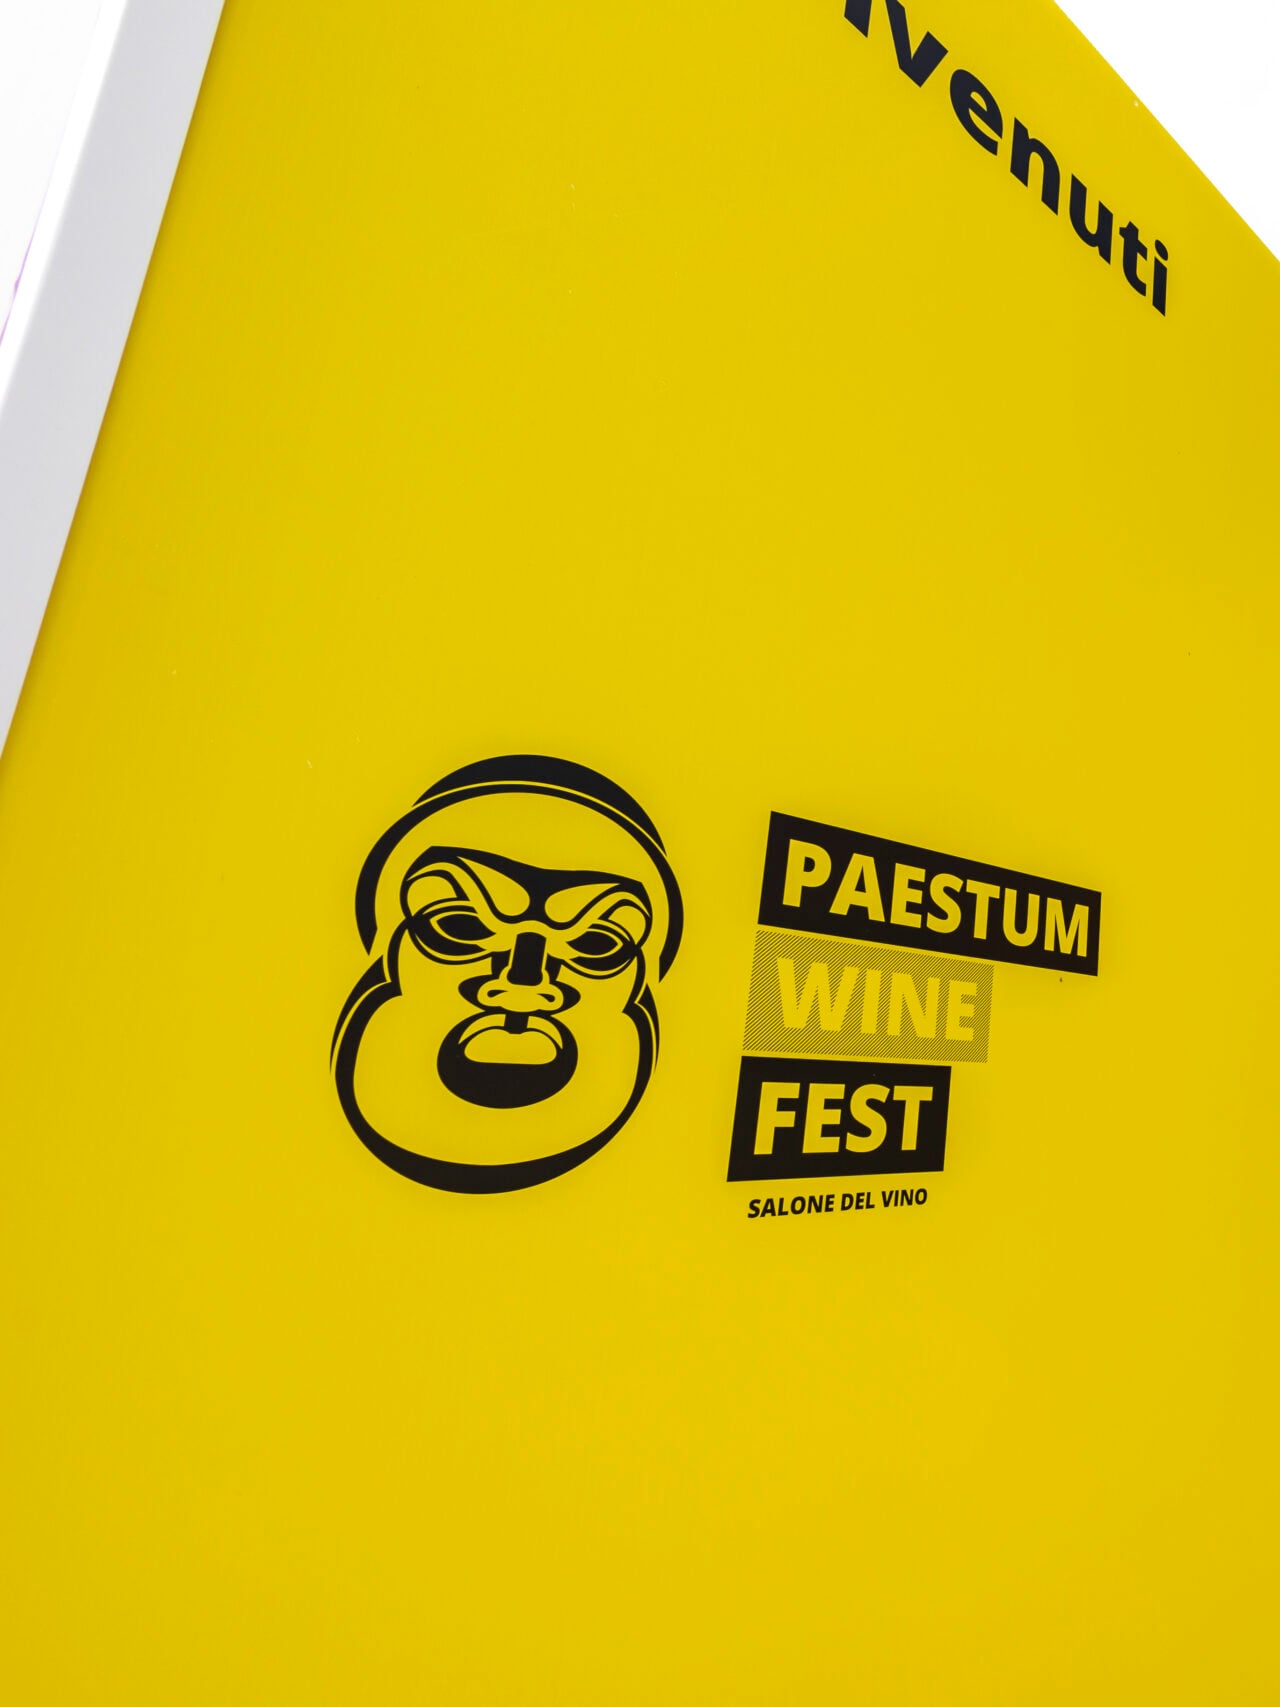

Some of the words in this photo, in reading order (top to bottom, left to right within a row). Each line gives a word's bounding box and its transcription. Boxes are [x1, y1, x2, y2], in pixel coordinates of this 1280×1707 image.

[782, 838, 1090, 958] PAESTUM
[776, 957, 977, 1042] WINE
[753, 1081, 934, 1156] FEST
[747, 1194, 836, 1219] SALONE
[840, 1191, 876, 1212] DEL
[881, 1188, 928, 1208] VINO
